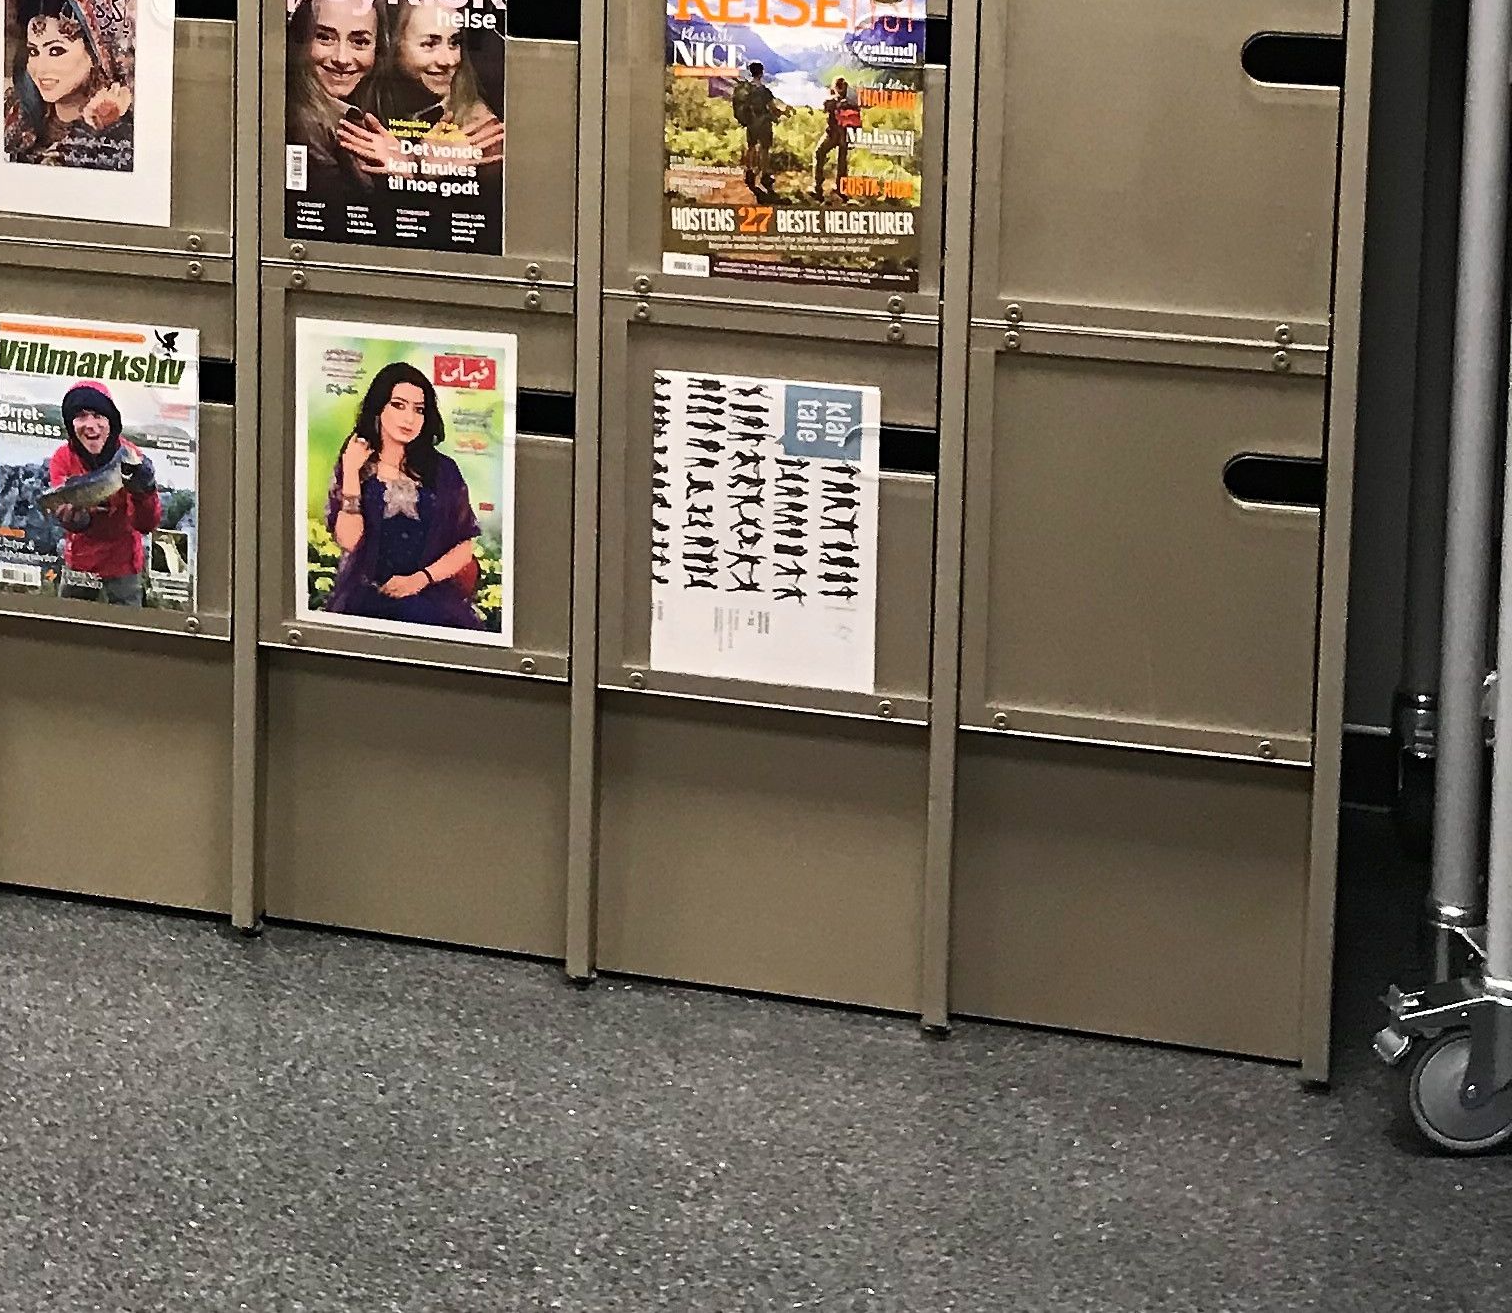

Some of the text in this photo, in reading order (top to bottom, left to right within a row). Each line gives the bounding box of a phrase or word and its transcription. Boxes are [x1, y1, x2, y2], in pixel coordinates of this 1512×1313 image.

[673, 39, 747, 71] NICE
[400, 139, 484, 160] Det vonde
[388, 158, 477, 178] kan brukes
[387, 175, 480, 197] til noe godt
[840, 176, 880, 197] COSTA
[739, 206, 774, 233] 27
[776, 210, 821, 234] BESTE
[824, 211, 915, 236] HELGETURER
[0, 419, 62, 437] suksess
[796, 399, 824, 443] tale
[824, 399, 853, 449] klar
